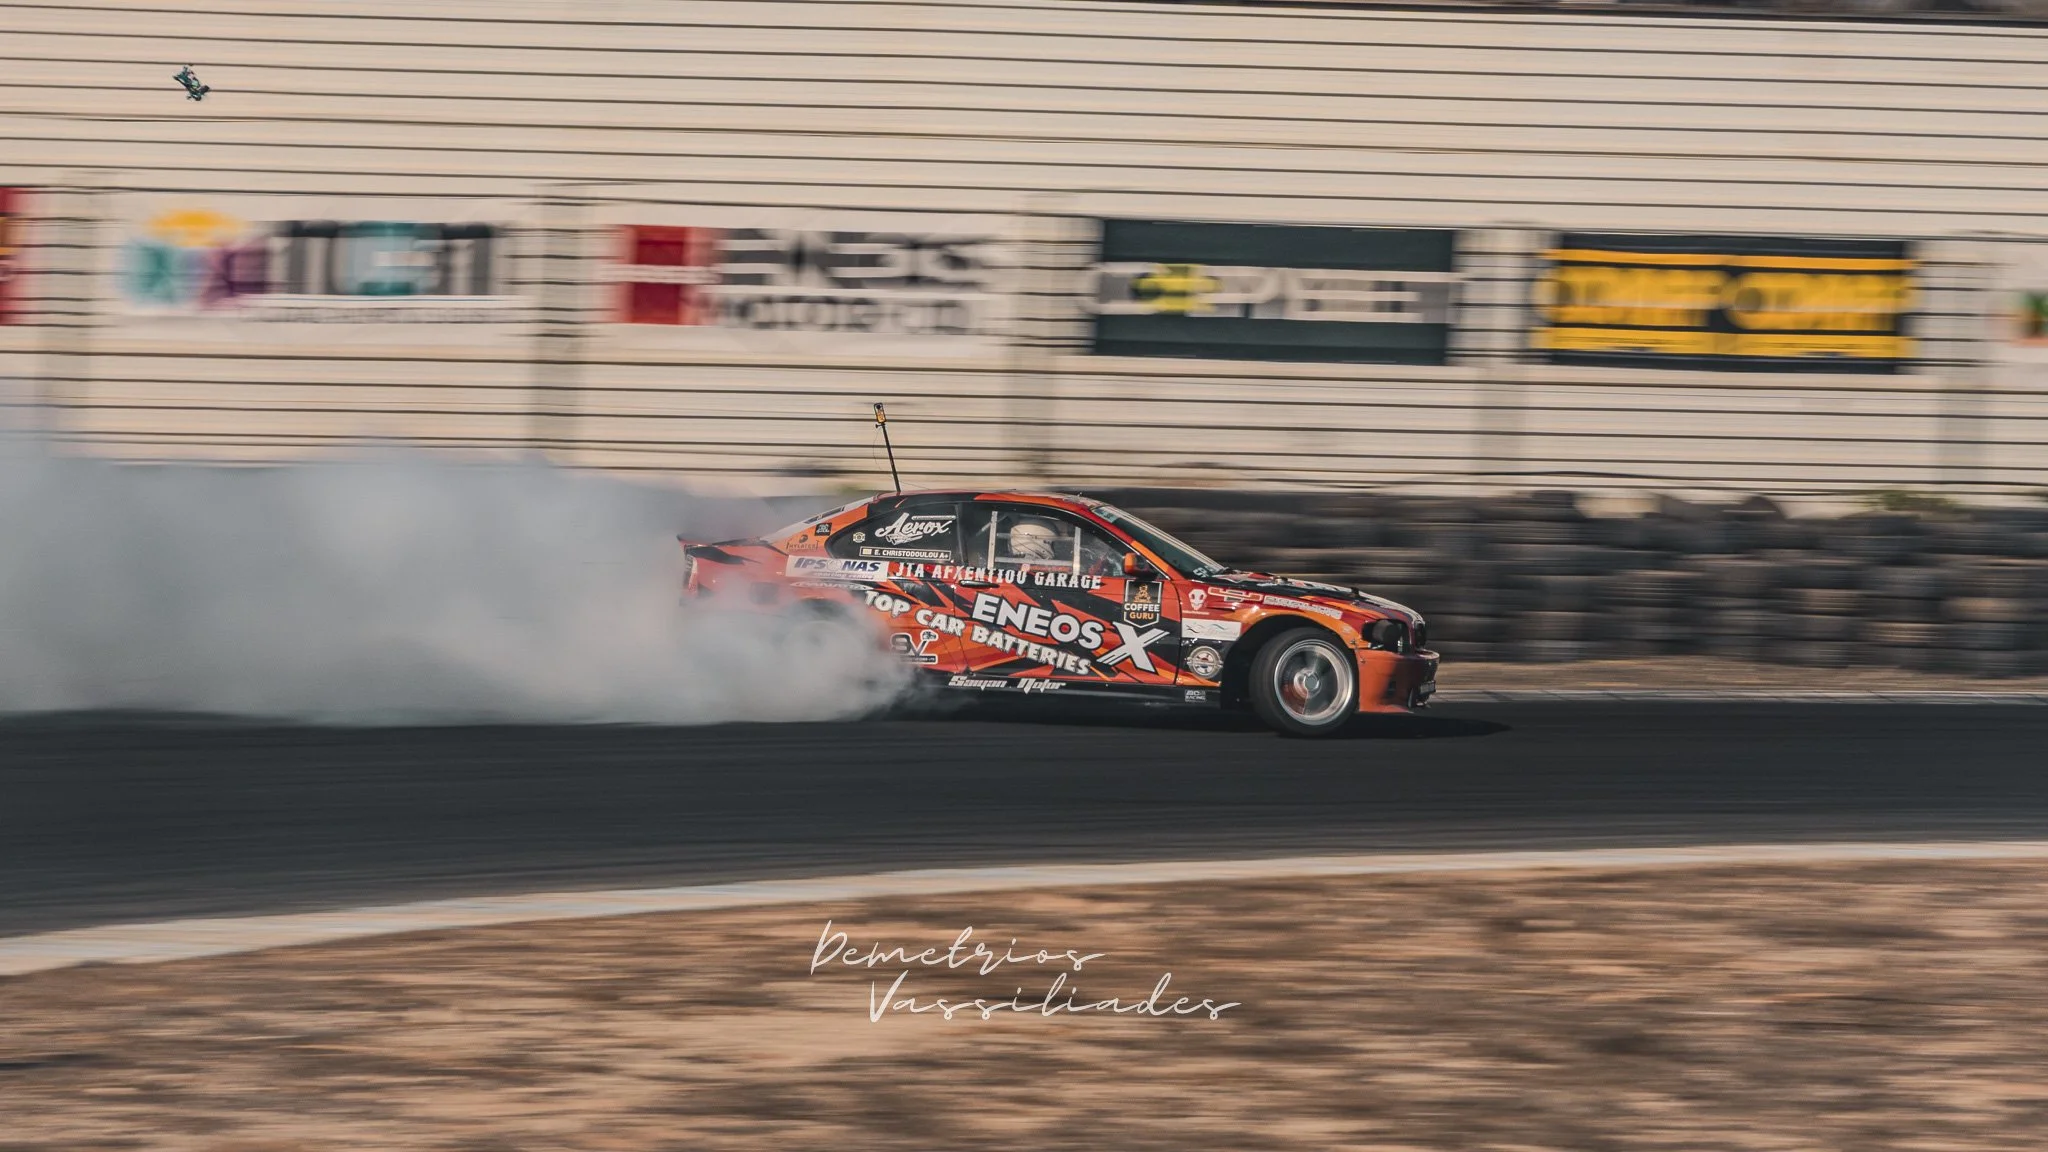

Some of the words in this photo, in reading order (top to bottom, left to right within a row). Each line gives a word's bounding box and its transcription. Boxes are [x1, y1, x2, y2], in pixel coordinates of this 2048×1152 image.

[875, 512, 953, 541] Aerox
[882, 550, 939, 559] CHRISTODOULOU
[931, 564, 1028, 585] AFXENTIOU
[1034, 571, 1102, 589] GARAGE
[1124, 602, 1160, 612] COFFEE
[1129, 612, 1154, 620] GURU
[865, 590, 912, 618] TOP
[915, 609, 966, 637] CAR
[971, 625, 1091, 676] BATTERIES
[972, 592, 1104, 650] ENEOS
[1096, 621, 1170, 674] X
